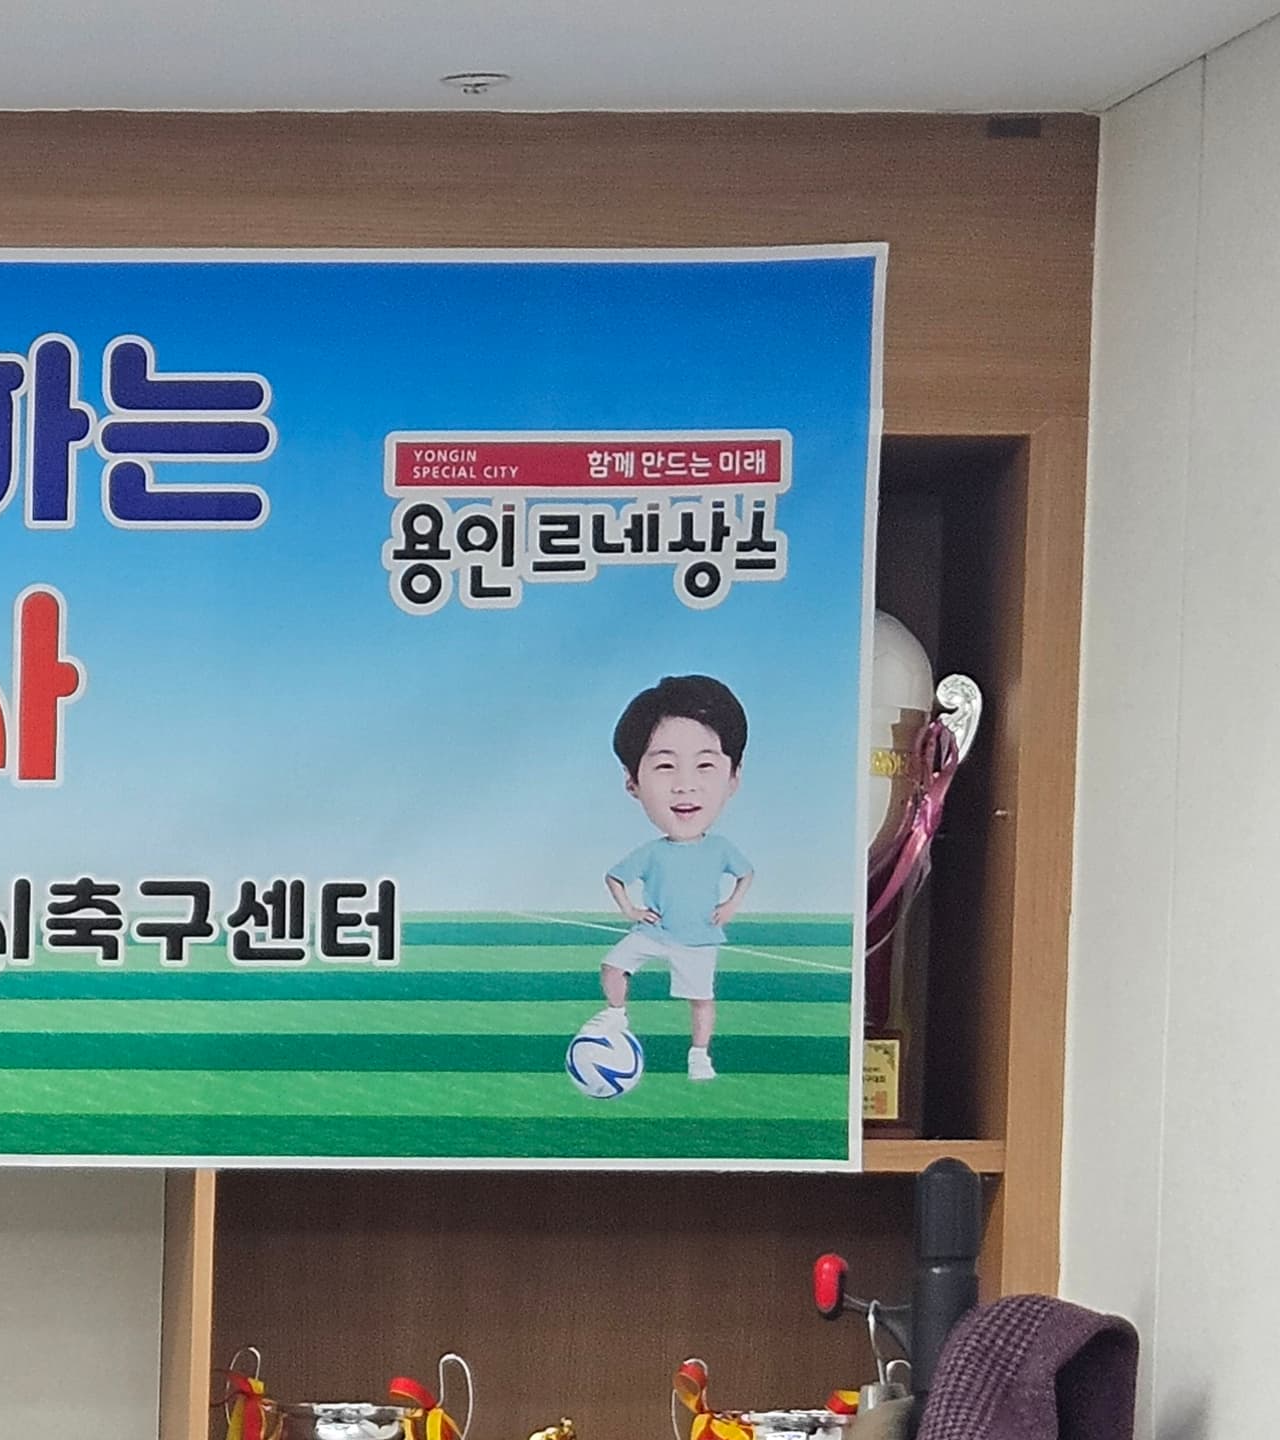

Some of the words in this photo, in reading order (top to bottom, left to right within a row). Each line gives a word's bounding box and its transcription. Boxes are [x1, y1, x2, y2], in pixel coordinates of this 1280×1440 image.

[413, 449, 477, 463] YONGIN
[587, 450, 635, 478] 함께
[641, 452, 712, 478] 만드는
[719, 449, 766, 475] 미래
[412, 466, 477, 480] SPECIAL
[483, 465, 519, 479] CITY
[392, 502, 516, 605] 용인
[532, 500, 777, 599] 르네상스
